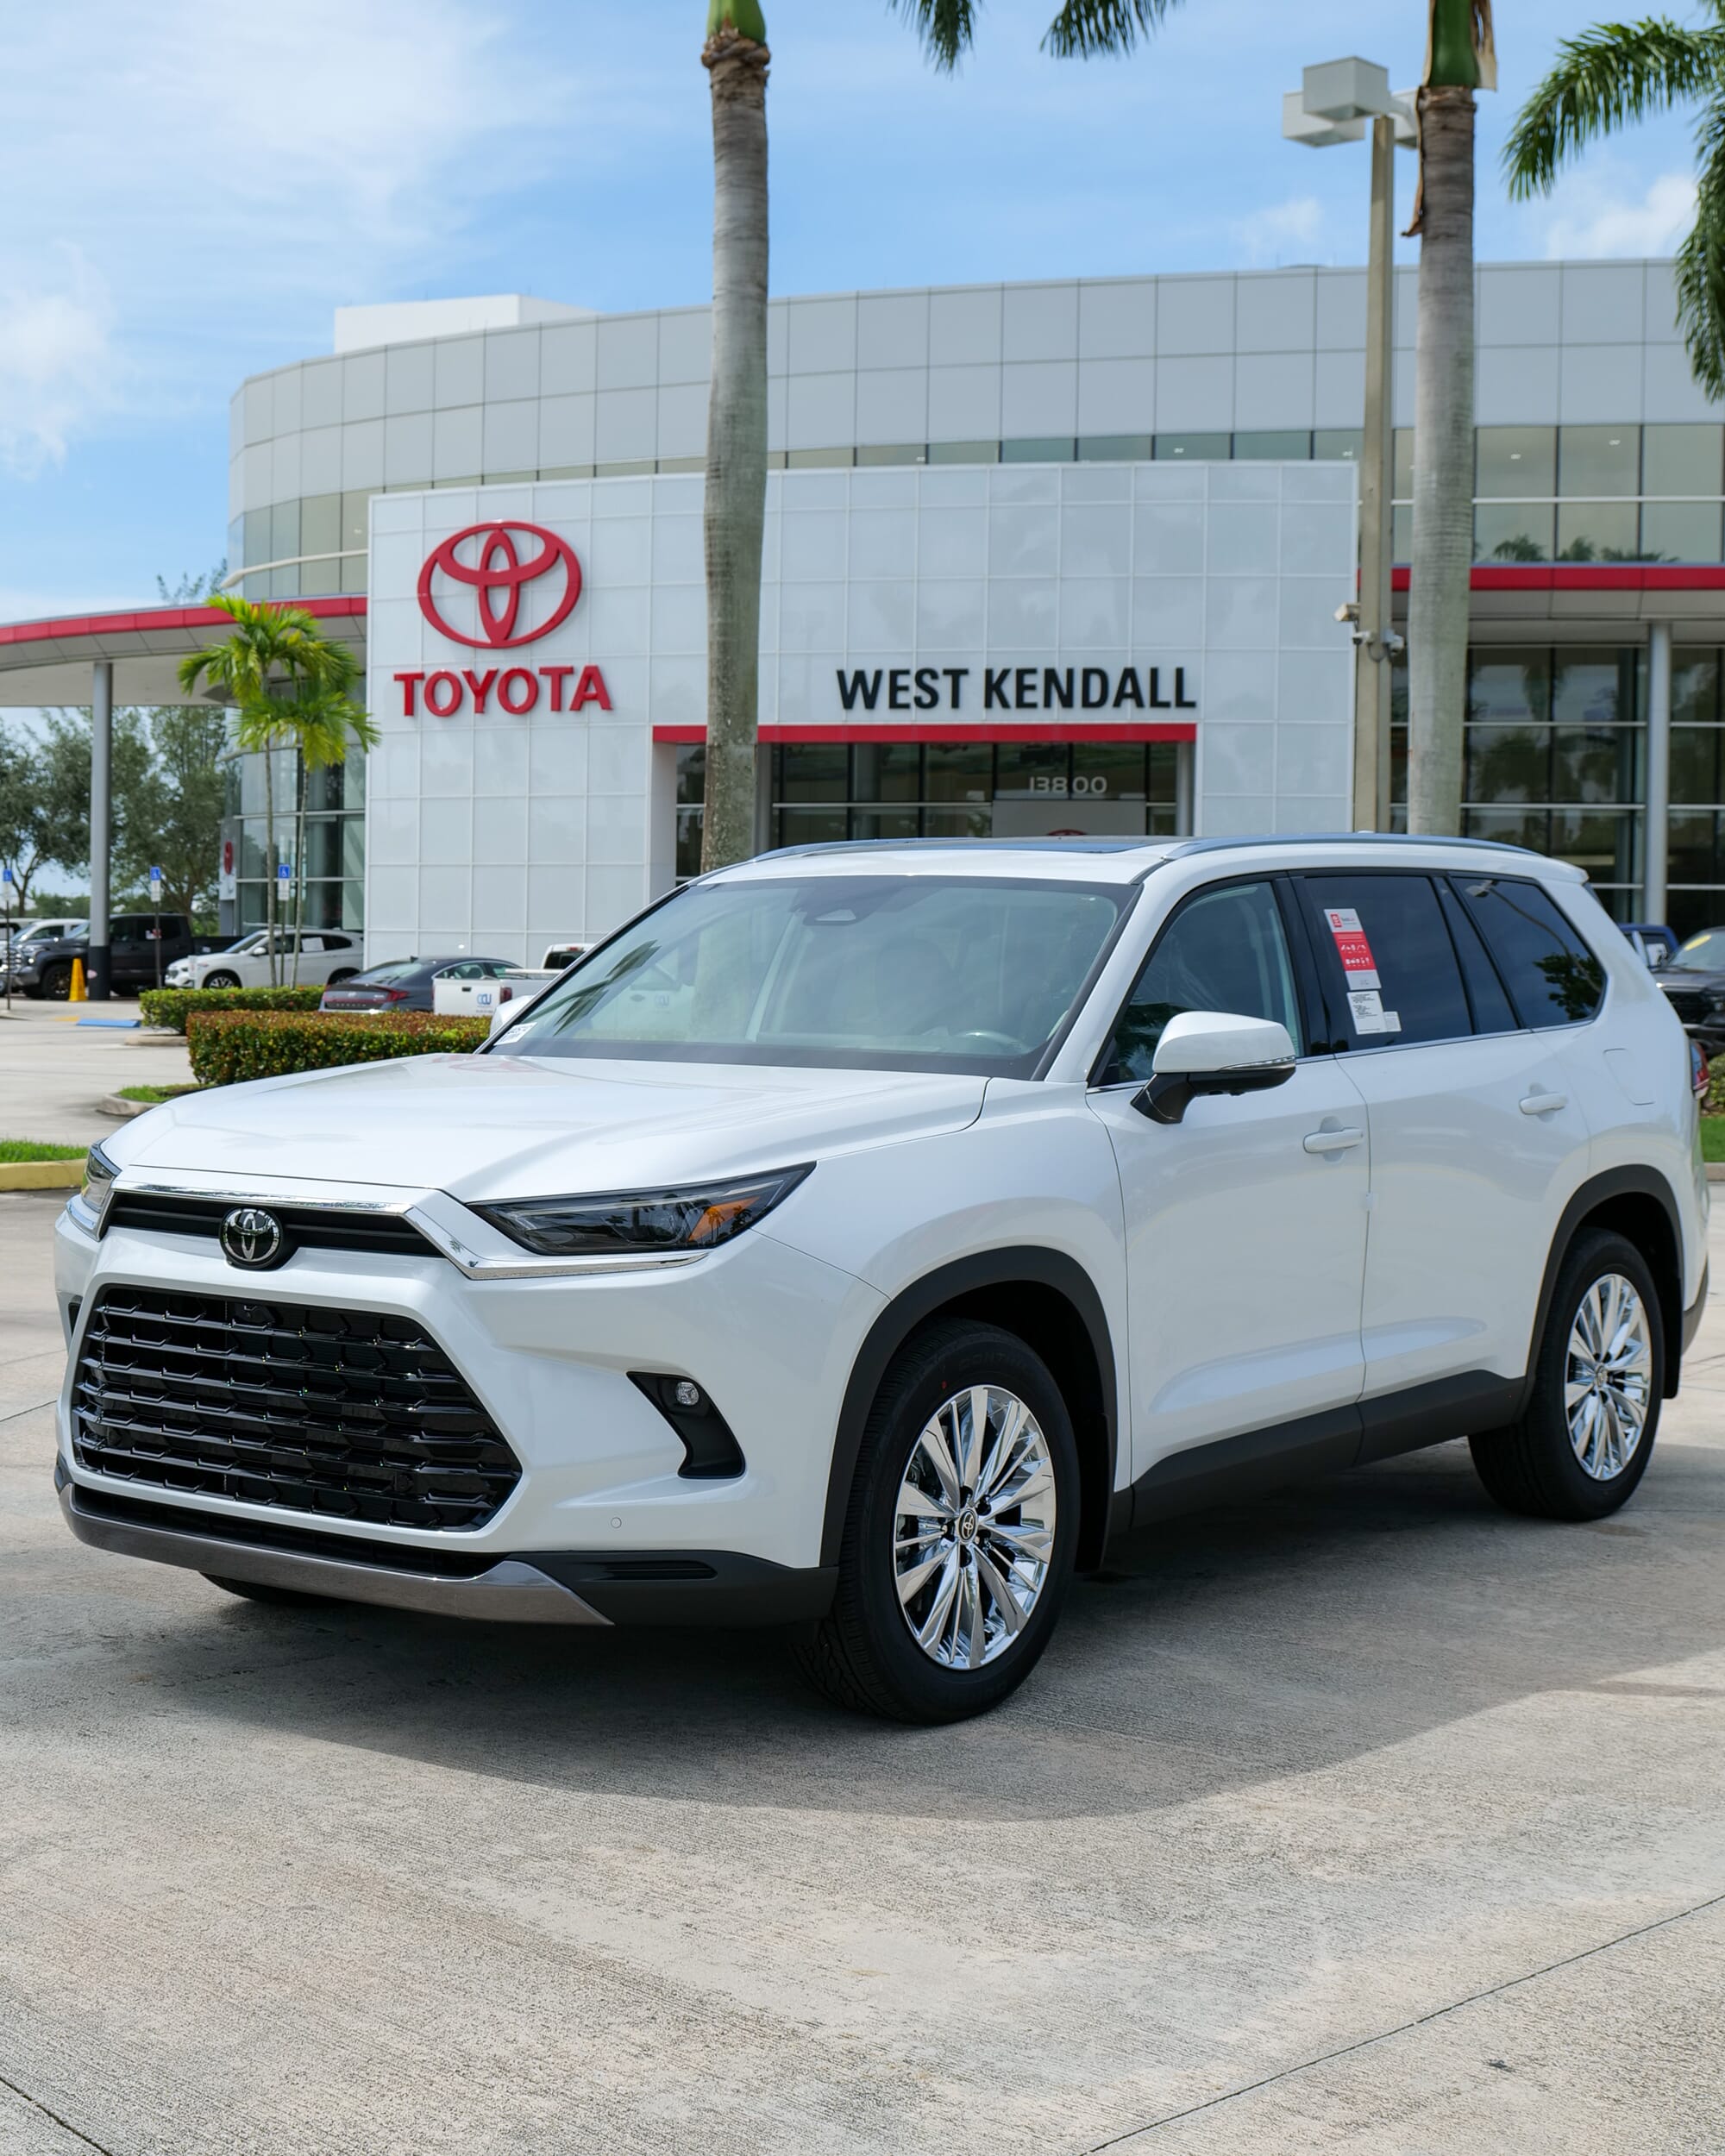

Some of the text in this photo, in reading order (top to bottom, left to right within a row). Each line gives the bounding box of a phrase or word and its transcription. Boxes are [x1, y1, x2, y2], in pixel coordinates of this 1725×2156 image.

[393, 665, 613, 718] TOYOTA
[837, 667, 1197, 710] WEST KENDALL
[1029, 776, 1107, 793] 13800
